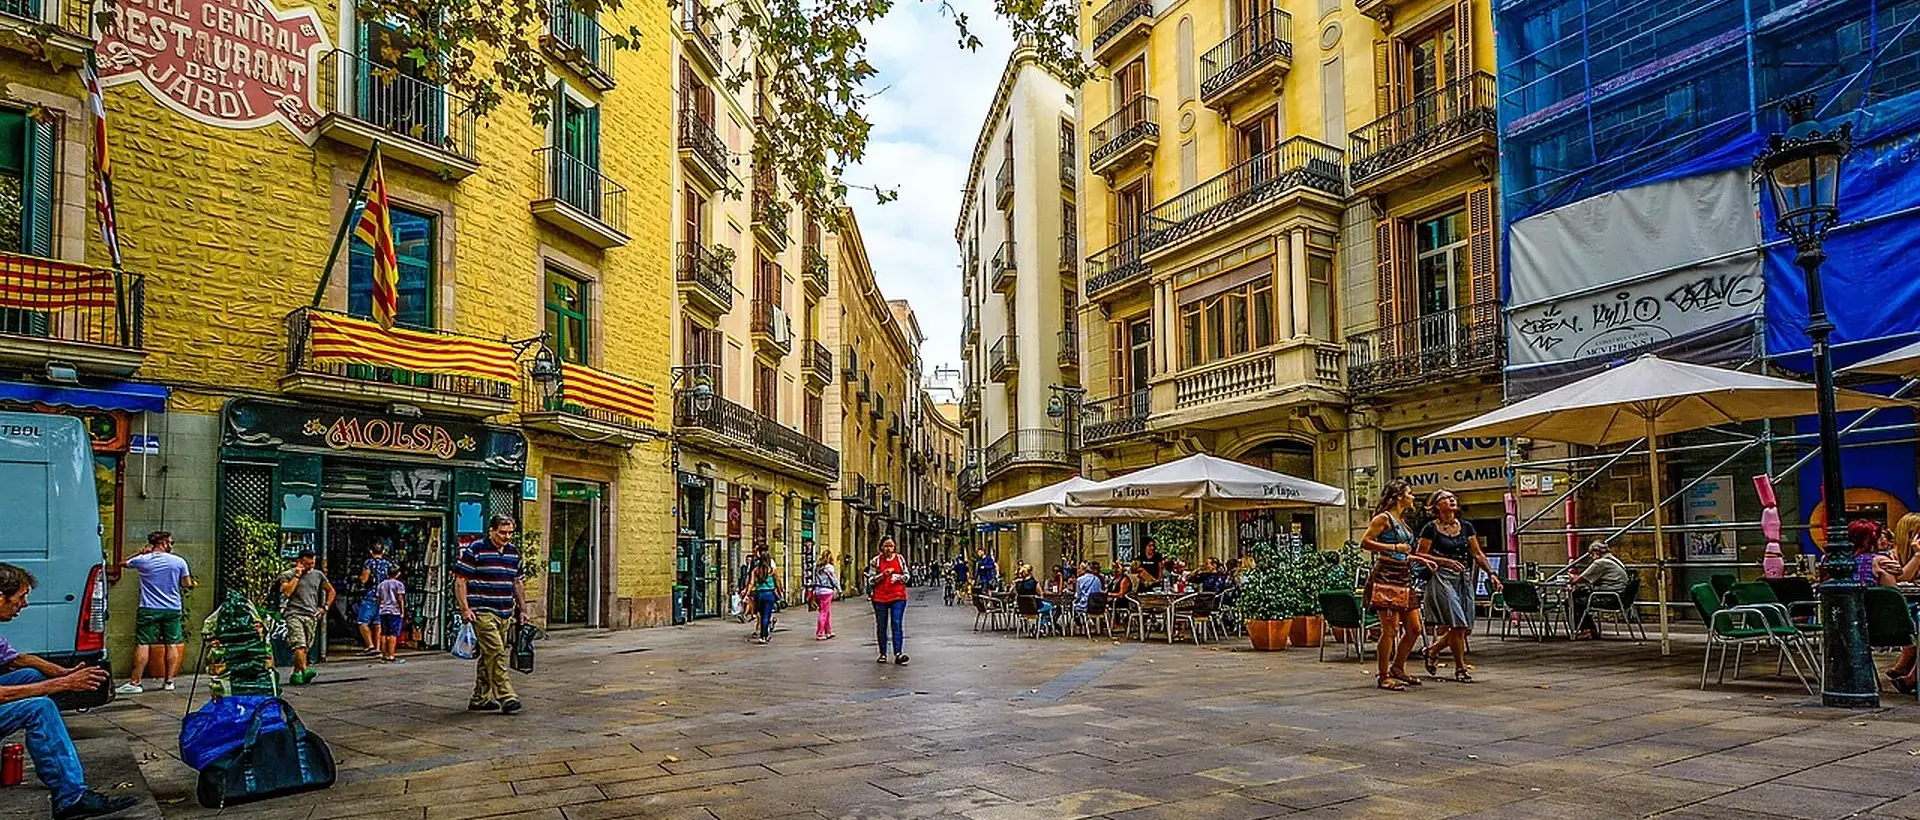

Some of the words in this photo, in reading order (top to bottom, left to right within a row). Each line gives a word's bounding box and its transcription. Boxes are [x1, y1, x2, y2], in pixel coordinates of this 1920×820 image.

[103, 1, 306, 93] RESTAURANT
[202, 3, 307, 59] CENTRAL
[325, 416, 456, 460] MOLSA
[1112, 487, 1122, 498] Pa
[1124, 485, 1150, 498] Tapas
